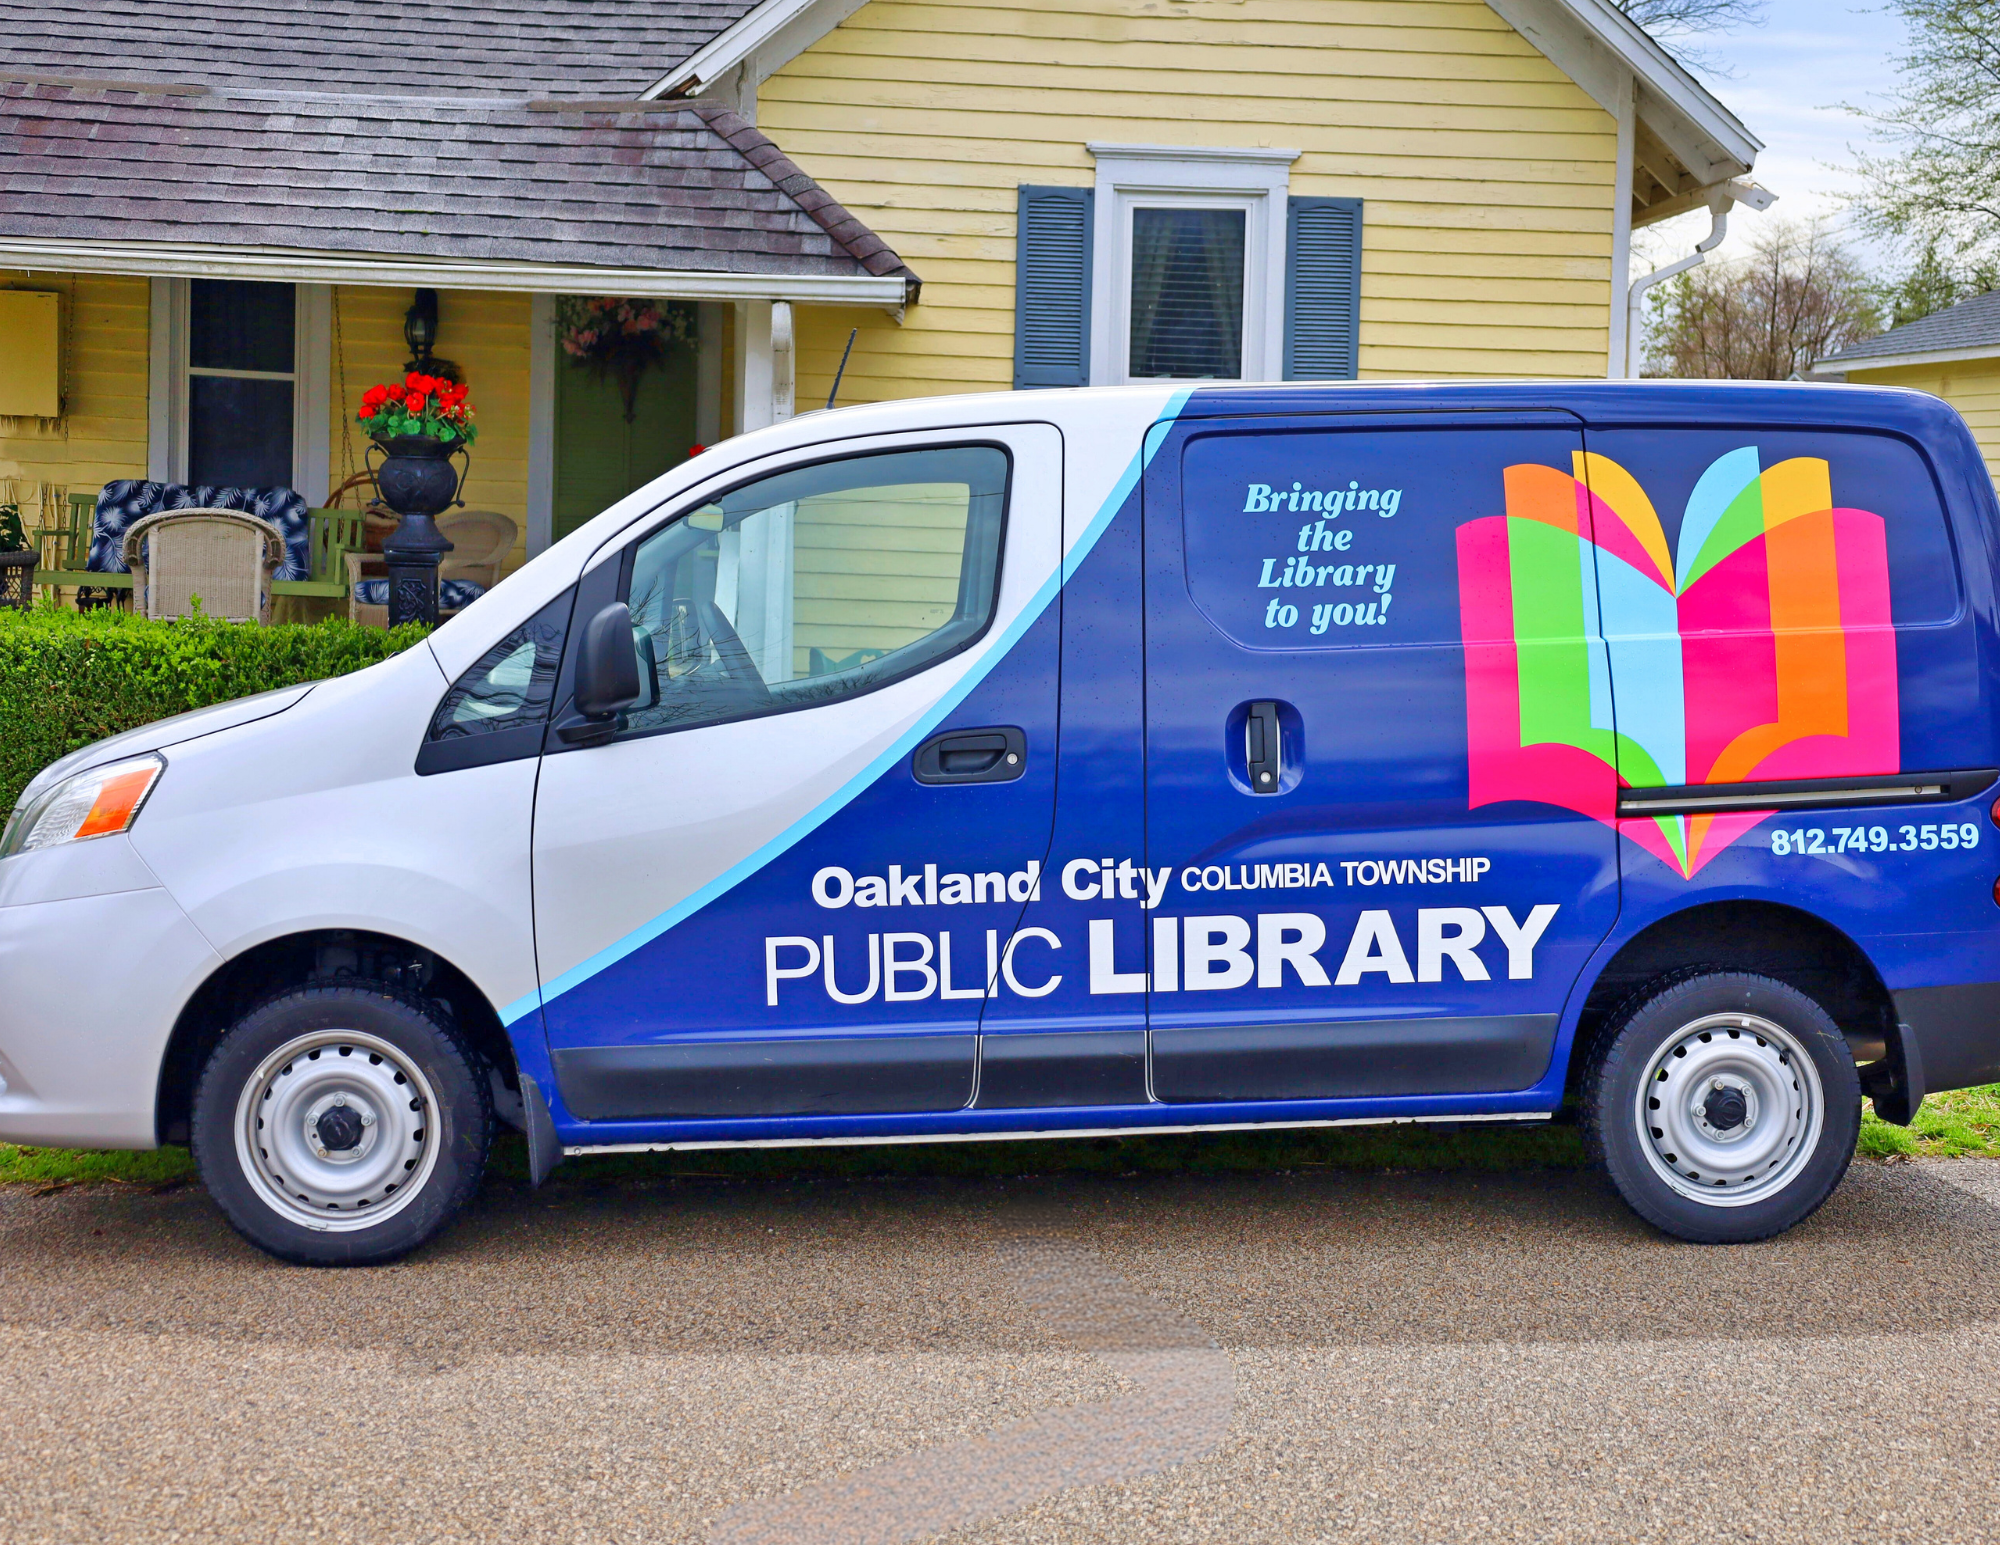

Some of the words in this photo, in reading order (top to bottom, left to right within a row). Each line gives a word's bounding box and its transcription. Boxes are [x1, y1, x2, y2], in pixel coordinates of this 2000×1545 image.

[1242, 480, 1403, 520] Bringing
[1297, 519, 1353, 553] the
[1257, 555, 1398, 594] Library
[1264, 597, 1299, 629] to
[1309, 592, 1393, 635] you!
[1770, 822, 1980, 858] 812.749.3559
[811, 859, 1040, 909] Oakland
[1061, 857, 1173, 910] City
[1180, 862, 1335, 892] COLUMBIA
[1339, 857, 1492, 887] TOWNSHIP
[764, 926, 1063, 1007] PUBLIC
[1088, 903, 1561, 995] LIBRARY
